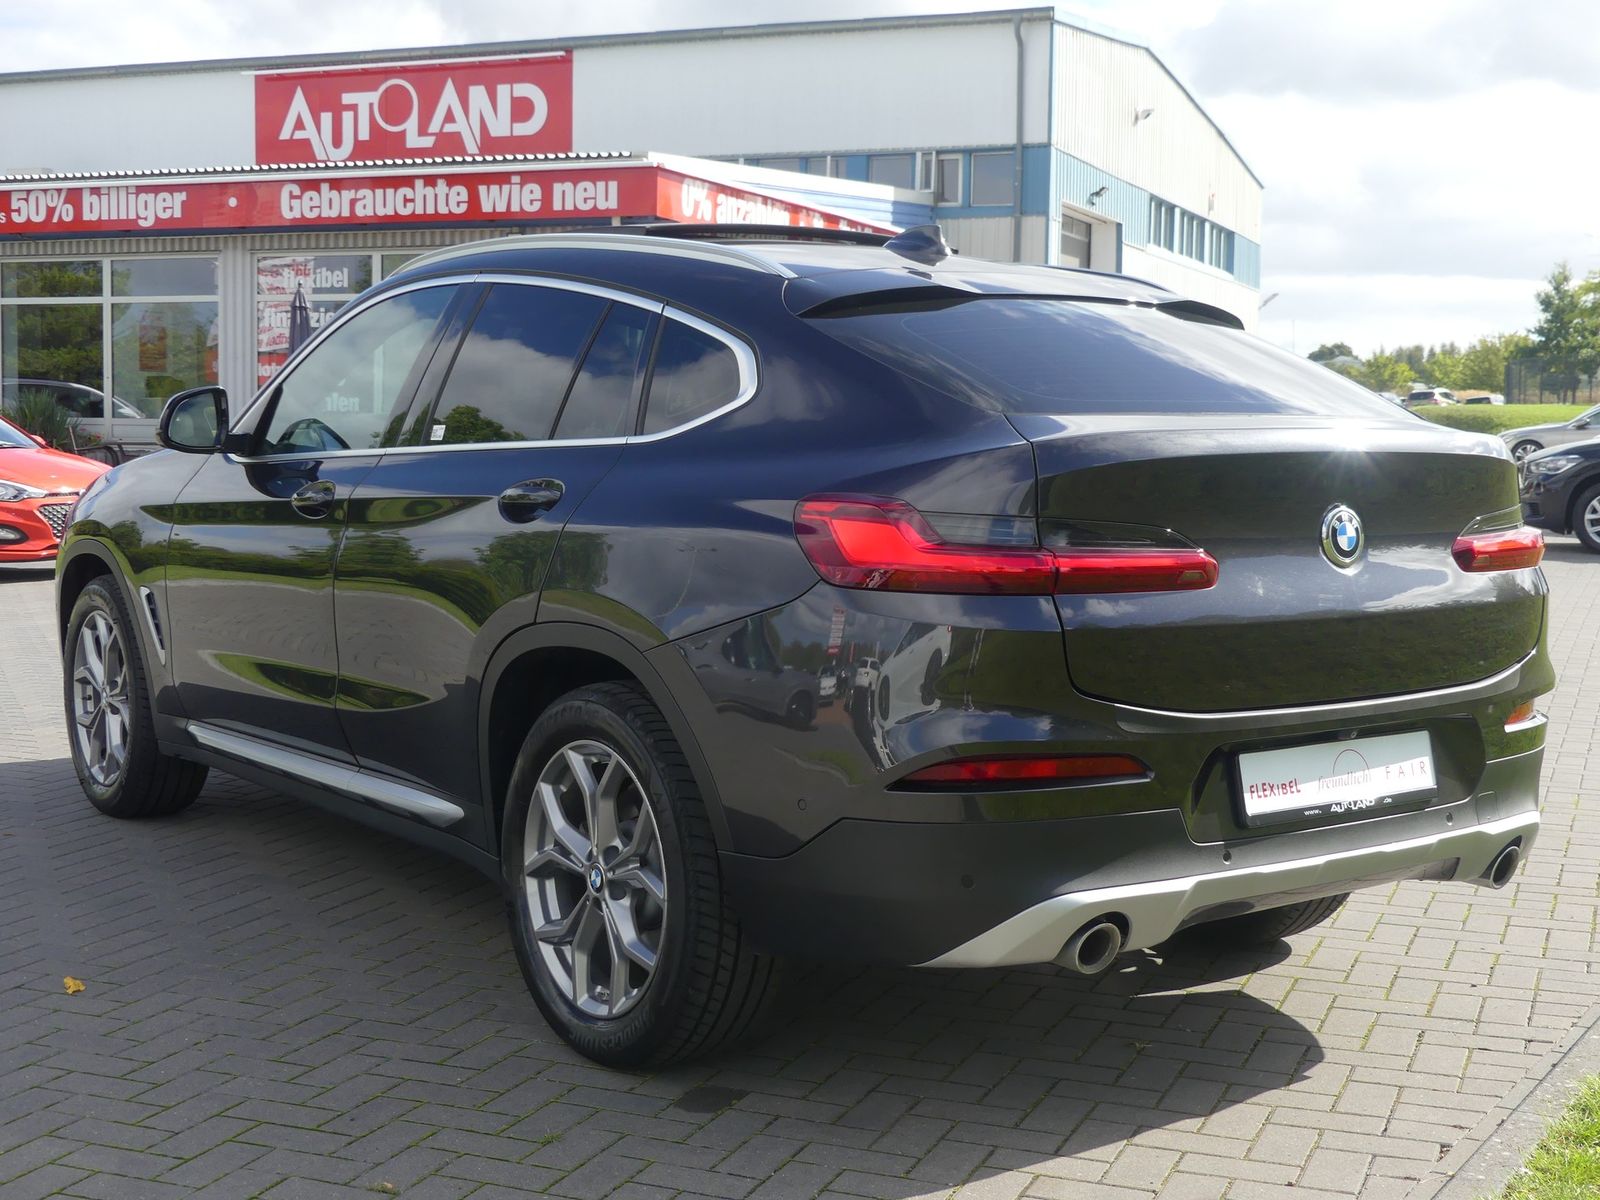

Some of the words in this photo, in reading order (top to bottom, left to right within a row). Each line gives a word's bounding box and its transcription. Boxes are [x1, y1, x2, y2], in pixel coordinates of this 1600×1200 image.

[279, 77, 548, 161] AUTOLAND
[11, 188, 74, 223] 50%
[82, 186, 188, 228] billiger
[280, 178, 469, 219] Gebrauchte
[478, 175, 542, 213] wie
[552, 180, 618, 211] neu
[681, 178, 712, 222] 0%
[1249, 778, 1301, 800] FLEXIBEL
[1317, 769, 1372, 793] freundlich
[1385, 761, 1427, 780] FAIR
